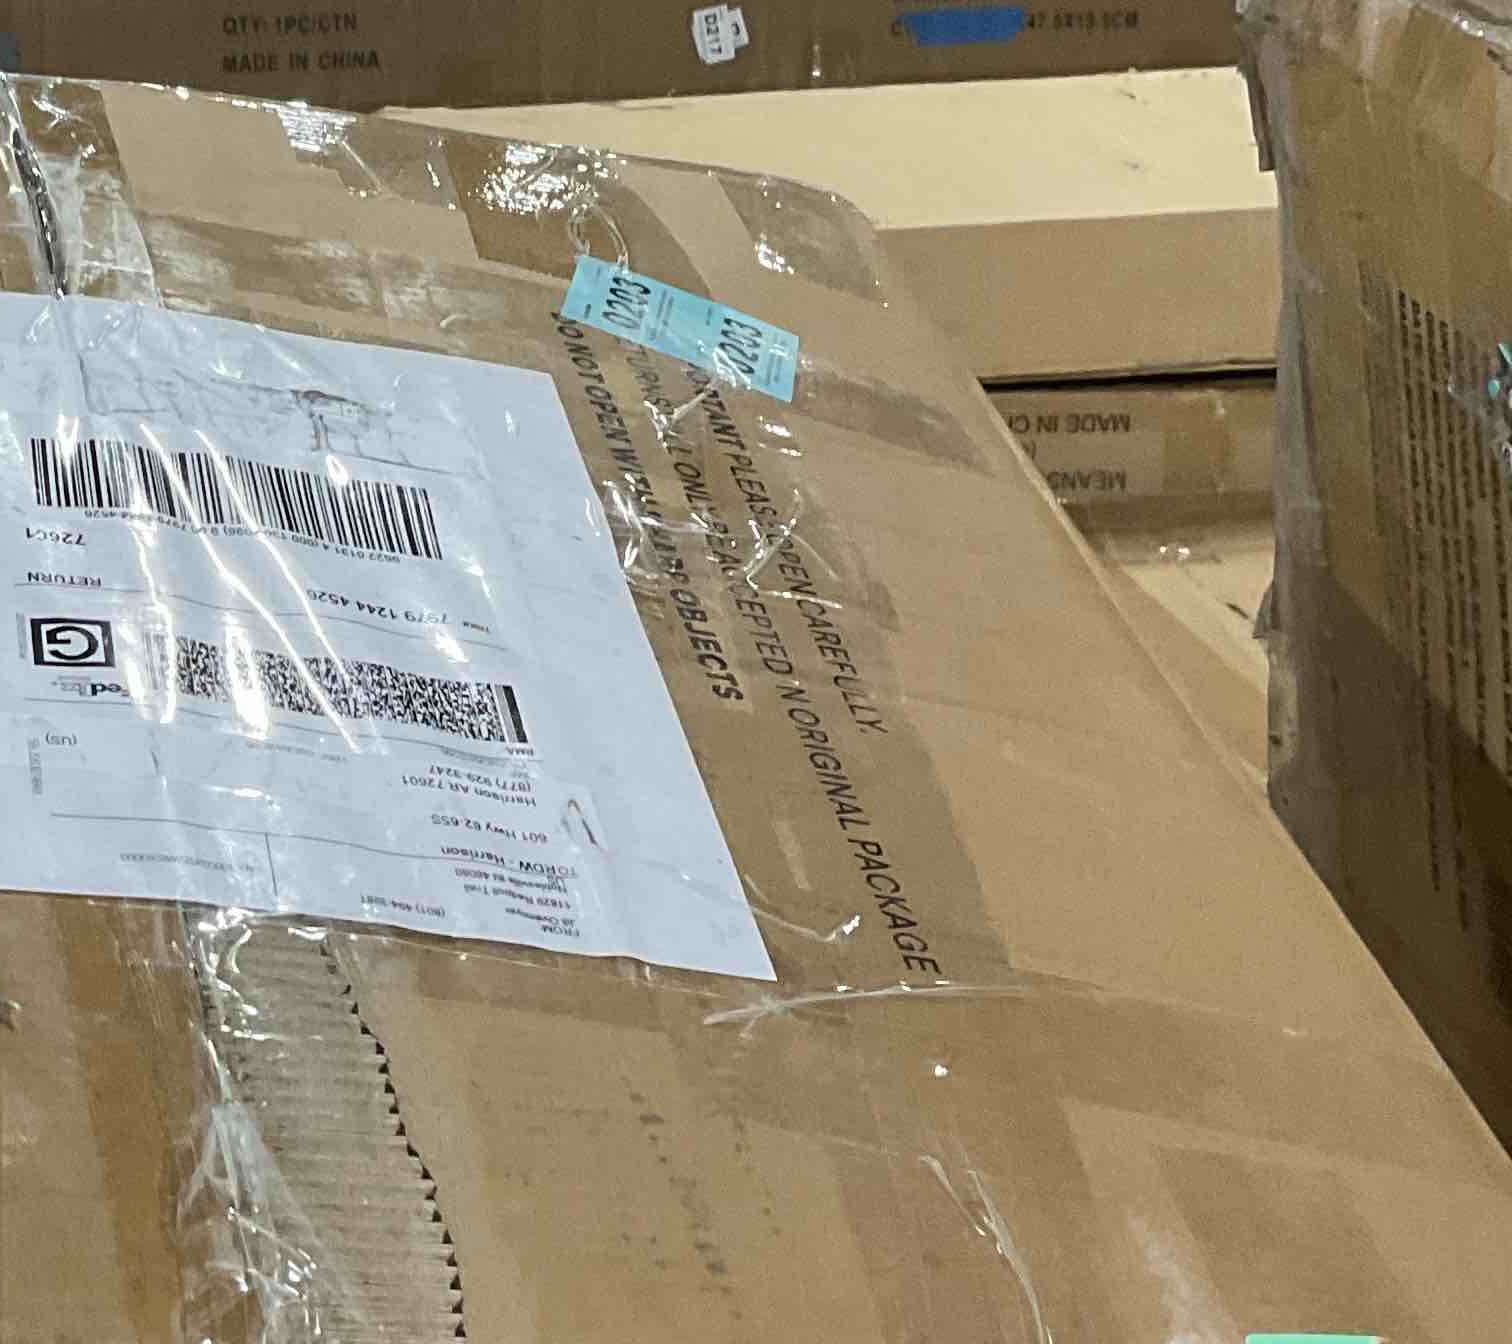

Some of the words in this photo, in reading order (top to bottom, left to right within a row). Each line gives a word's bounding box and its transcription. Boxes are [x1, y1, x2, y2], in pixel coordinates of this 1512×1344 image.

[222, 52, 280, 72] MADE
[289, 51, 309, 71] IN
[319, 49, 381, 71] CHINA
[1038, 415, 1059, 433] IN
[1065, 414, 1130, 433] MADE
[568, 341, 600, 386] NOT
[670, 586, 744, 703] OBJECTS
[27, 571, 103, 587] RETURN
[356, 600, 397, 620] 1244
[46, 624, 99, 662] G
[794, 592, 889, 735] CAREFULLY.
[45, 732, 78, 746] (US)
[474, 786, 537, 807] Harrison
[788, 706, 871, 831] ORIGINAL
[848, 837, 944, 975] PACKAGE
[441, 844, 506, 866] Harrison
